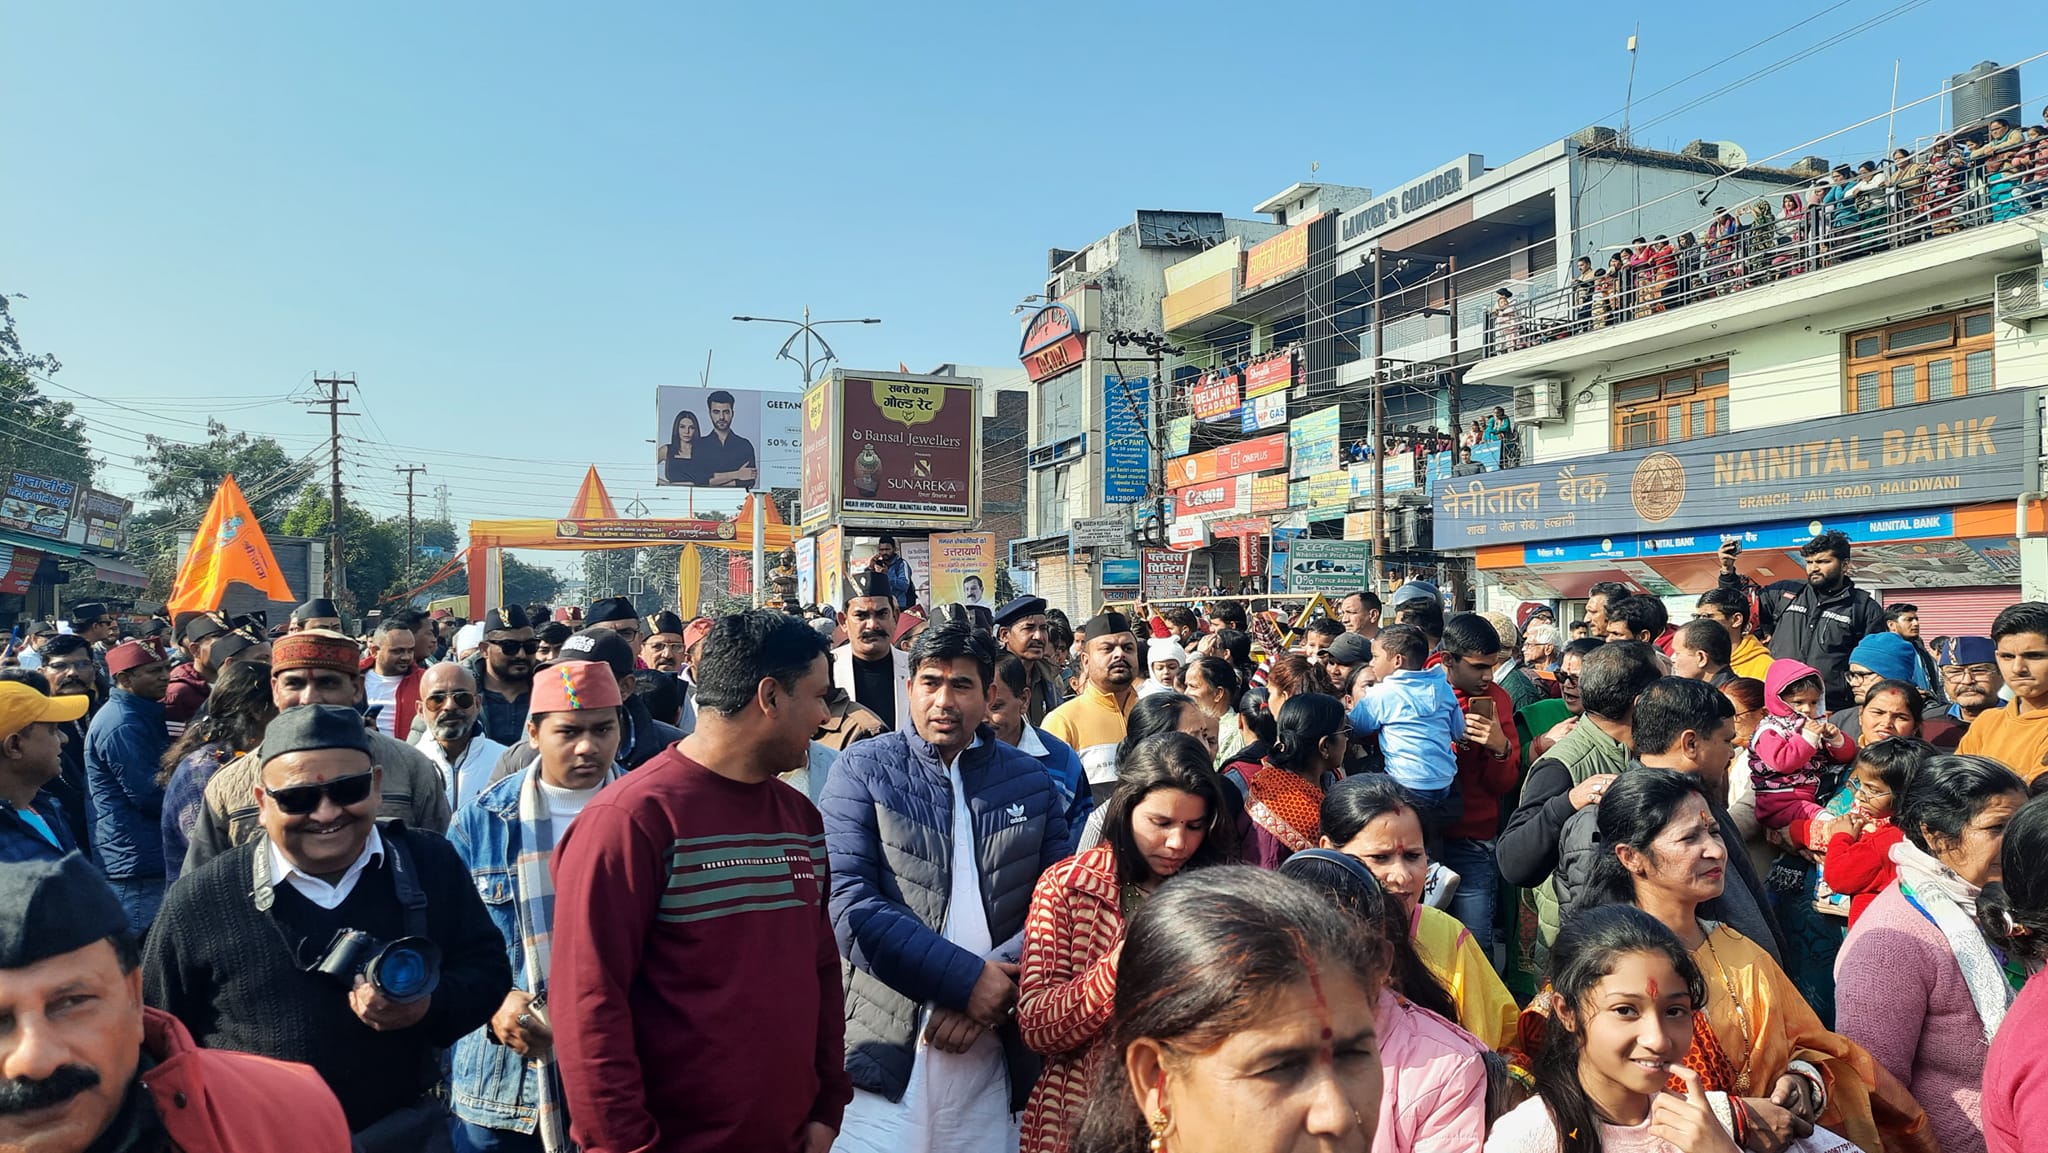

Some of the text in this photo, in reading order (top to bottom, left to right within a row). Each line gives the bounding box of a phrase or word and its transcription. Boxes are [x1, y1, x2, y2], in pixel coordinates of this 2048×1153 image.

[1343, 167, 1462, 241] LAWYER'S CHAMBER
[888, 384, 929, 395] सबसे कम
[1195, 389, 1220, 404] DELHI
[1222, 383, 1237, 399] IAS
[767, 401, 802, 409] GEETAN
[883, 395, 933, 411] गोल्ड रेट
[1197, 396, 1238, 413] ACADEMY
[1258, 407, 1285, 422] HP GAS
[767, 439, 788, 447] 50%
[865, 430, 961, 447] Bansal Jewellers
[1242, 450, 1268, 463] ONEPLUS
[1713, 416, 1998, 488] NAINITAL BANK
[42, 480, 58, 493] जी
[58, 483, 74, 495] के
[888, 478, 956, 492] SUNAREKA
[1441, 464, 1609, 519] नैनीताल बैंक
[1738, 492, 1790, 509] BRANCH
[1801, 488, 1828, 504] JAIL
[1833, 484, 1875, 500] ROAD,
[1880, 475, 1961, 495] HALDWANI
[1185, 486, 1225, 508] Canon
[1466, 524, 1487, 536] शाखा
[1499, 520, 1515, 533] जेल
[1869, 516, 1940, 532] NAINITAL BANK
[1296, 543, 1329, 551] acer
[1675, 537, 1695, 547] BANK
[943, 545, 982, 557] उत्तरायणी
[1296, 575, 1314, 585] 0%
